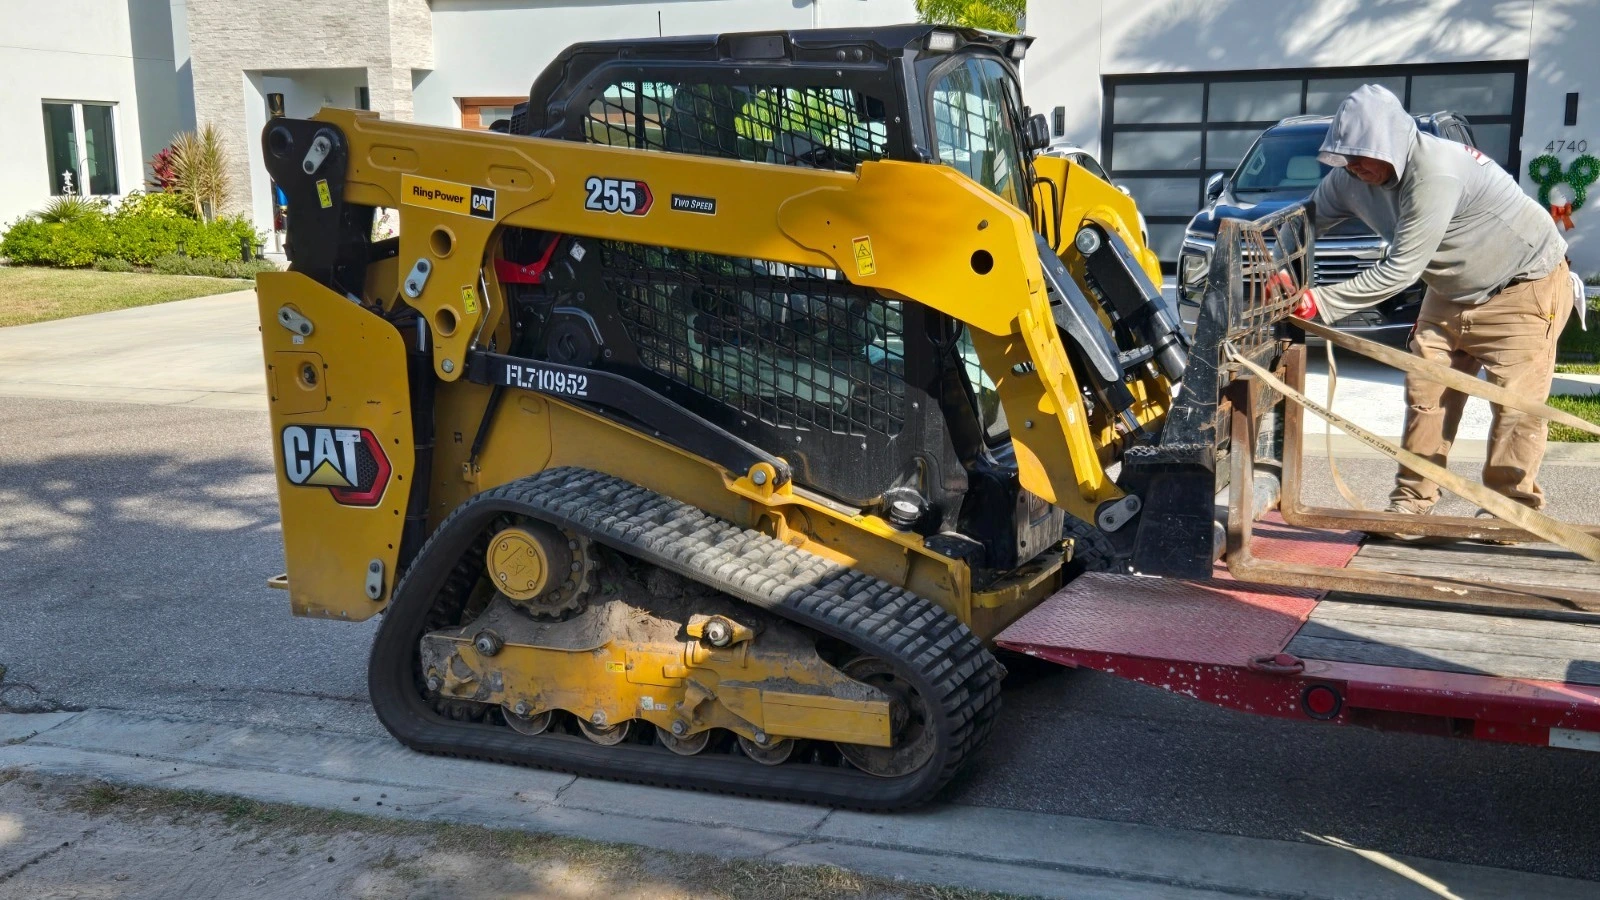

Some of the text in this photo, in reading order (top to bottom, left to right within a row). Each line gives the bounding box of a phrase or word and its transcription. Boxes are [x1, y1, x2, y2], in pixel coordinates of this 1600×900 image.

[1545, 140, 1588, 153] 4740
[413, 186, 464, 204] Ring Power
[472, 194, 493, 212] CAT
[586, 177, 637, 213] 255
[506, 364, 588, 397] FL710952
[283, 425, 362, 488] CAT
